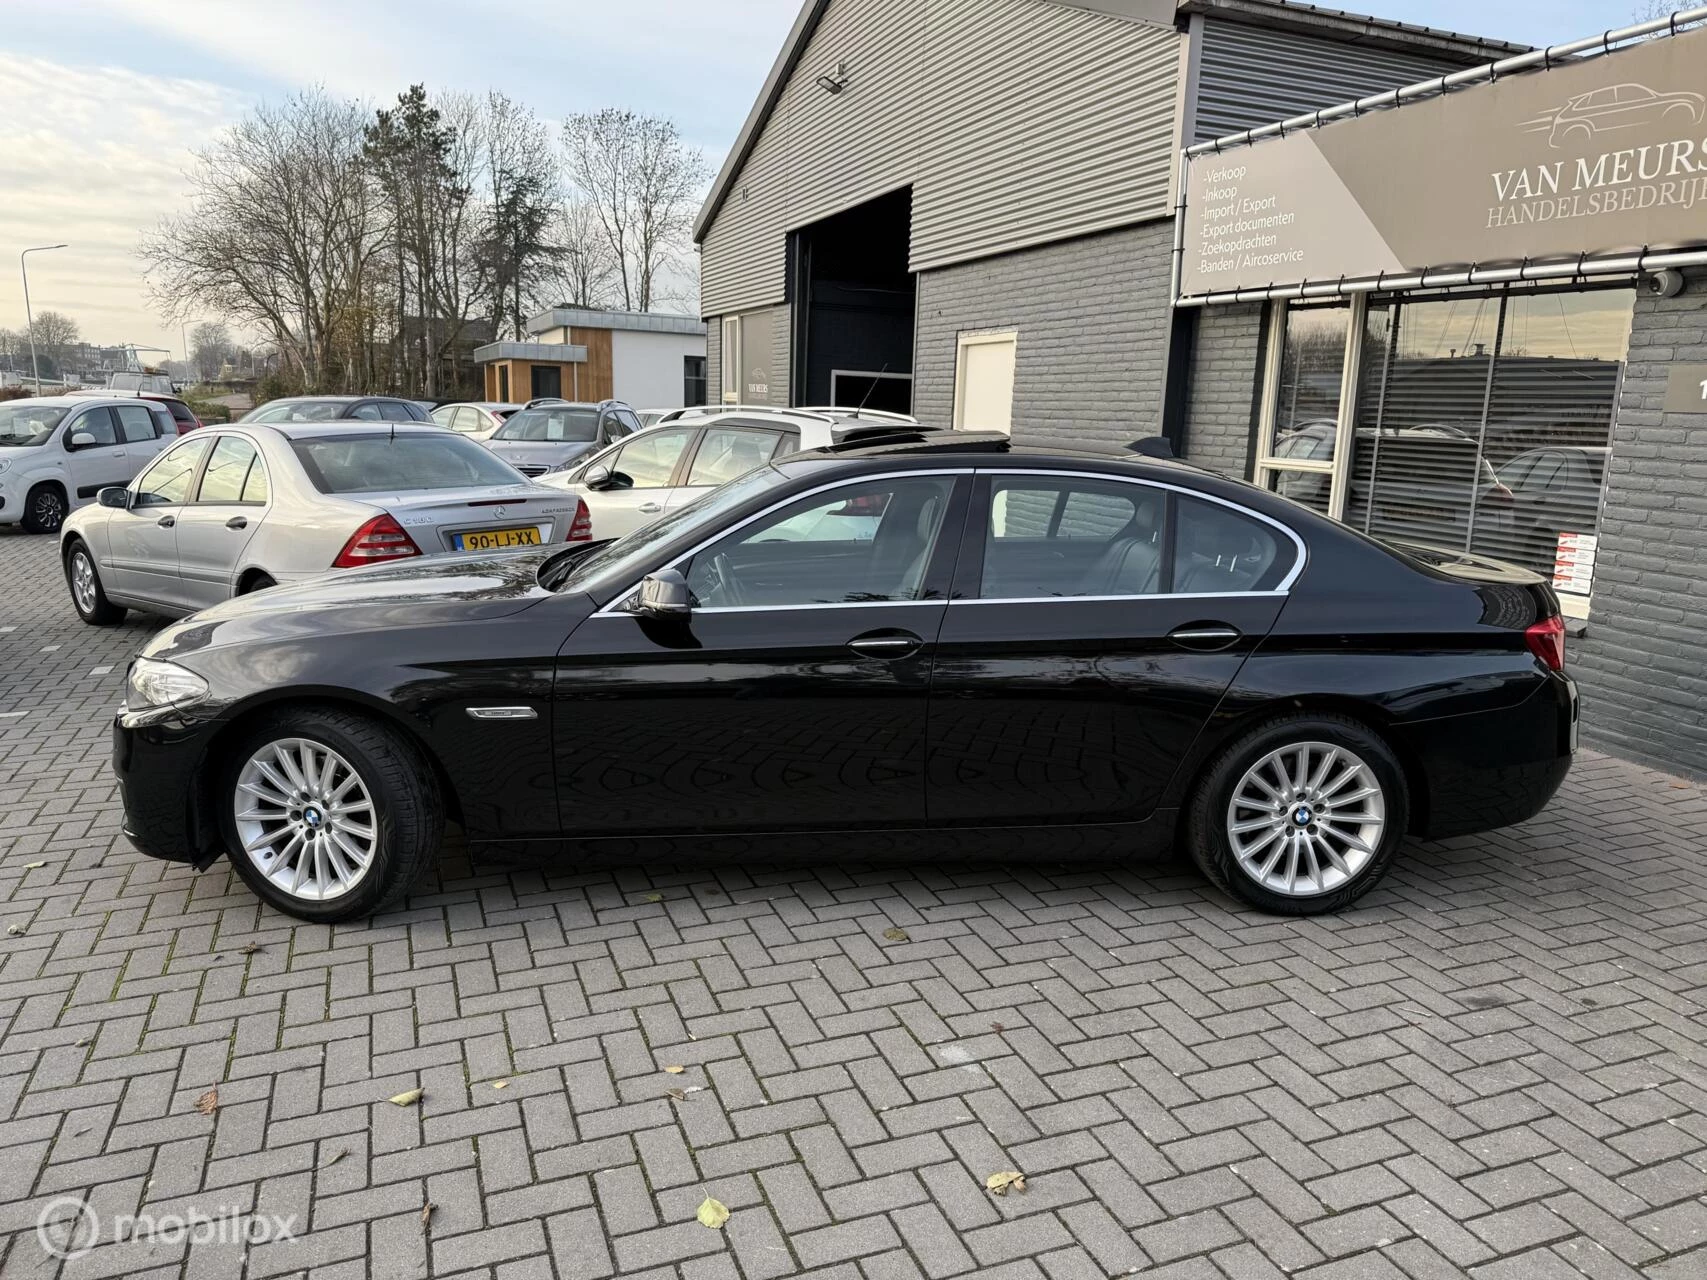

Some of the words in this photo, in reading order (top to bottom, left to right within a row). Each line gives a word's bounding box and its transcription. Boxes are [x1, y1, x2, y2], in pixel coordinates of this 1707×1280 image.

[1491, 161, 1565, 202] VAN
[1242, 195, 1276, 214] Export
[1234, 212, 1295, 233] documenten
[1242, 247, 1304, 268] Aircoservice
[469, 531, 535, 550] 90-LJ-XX
